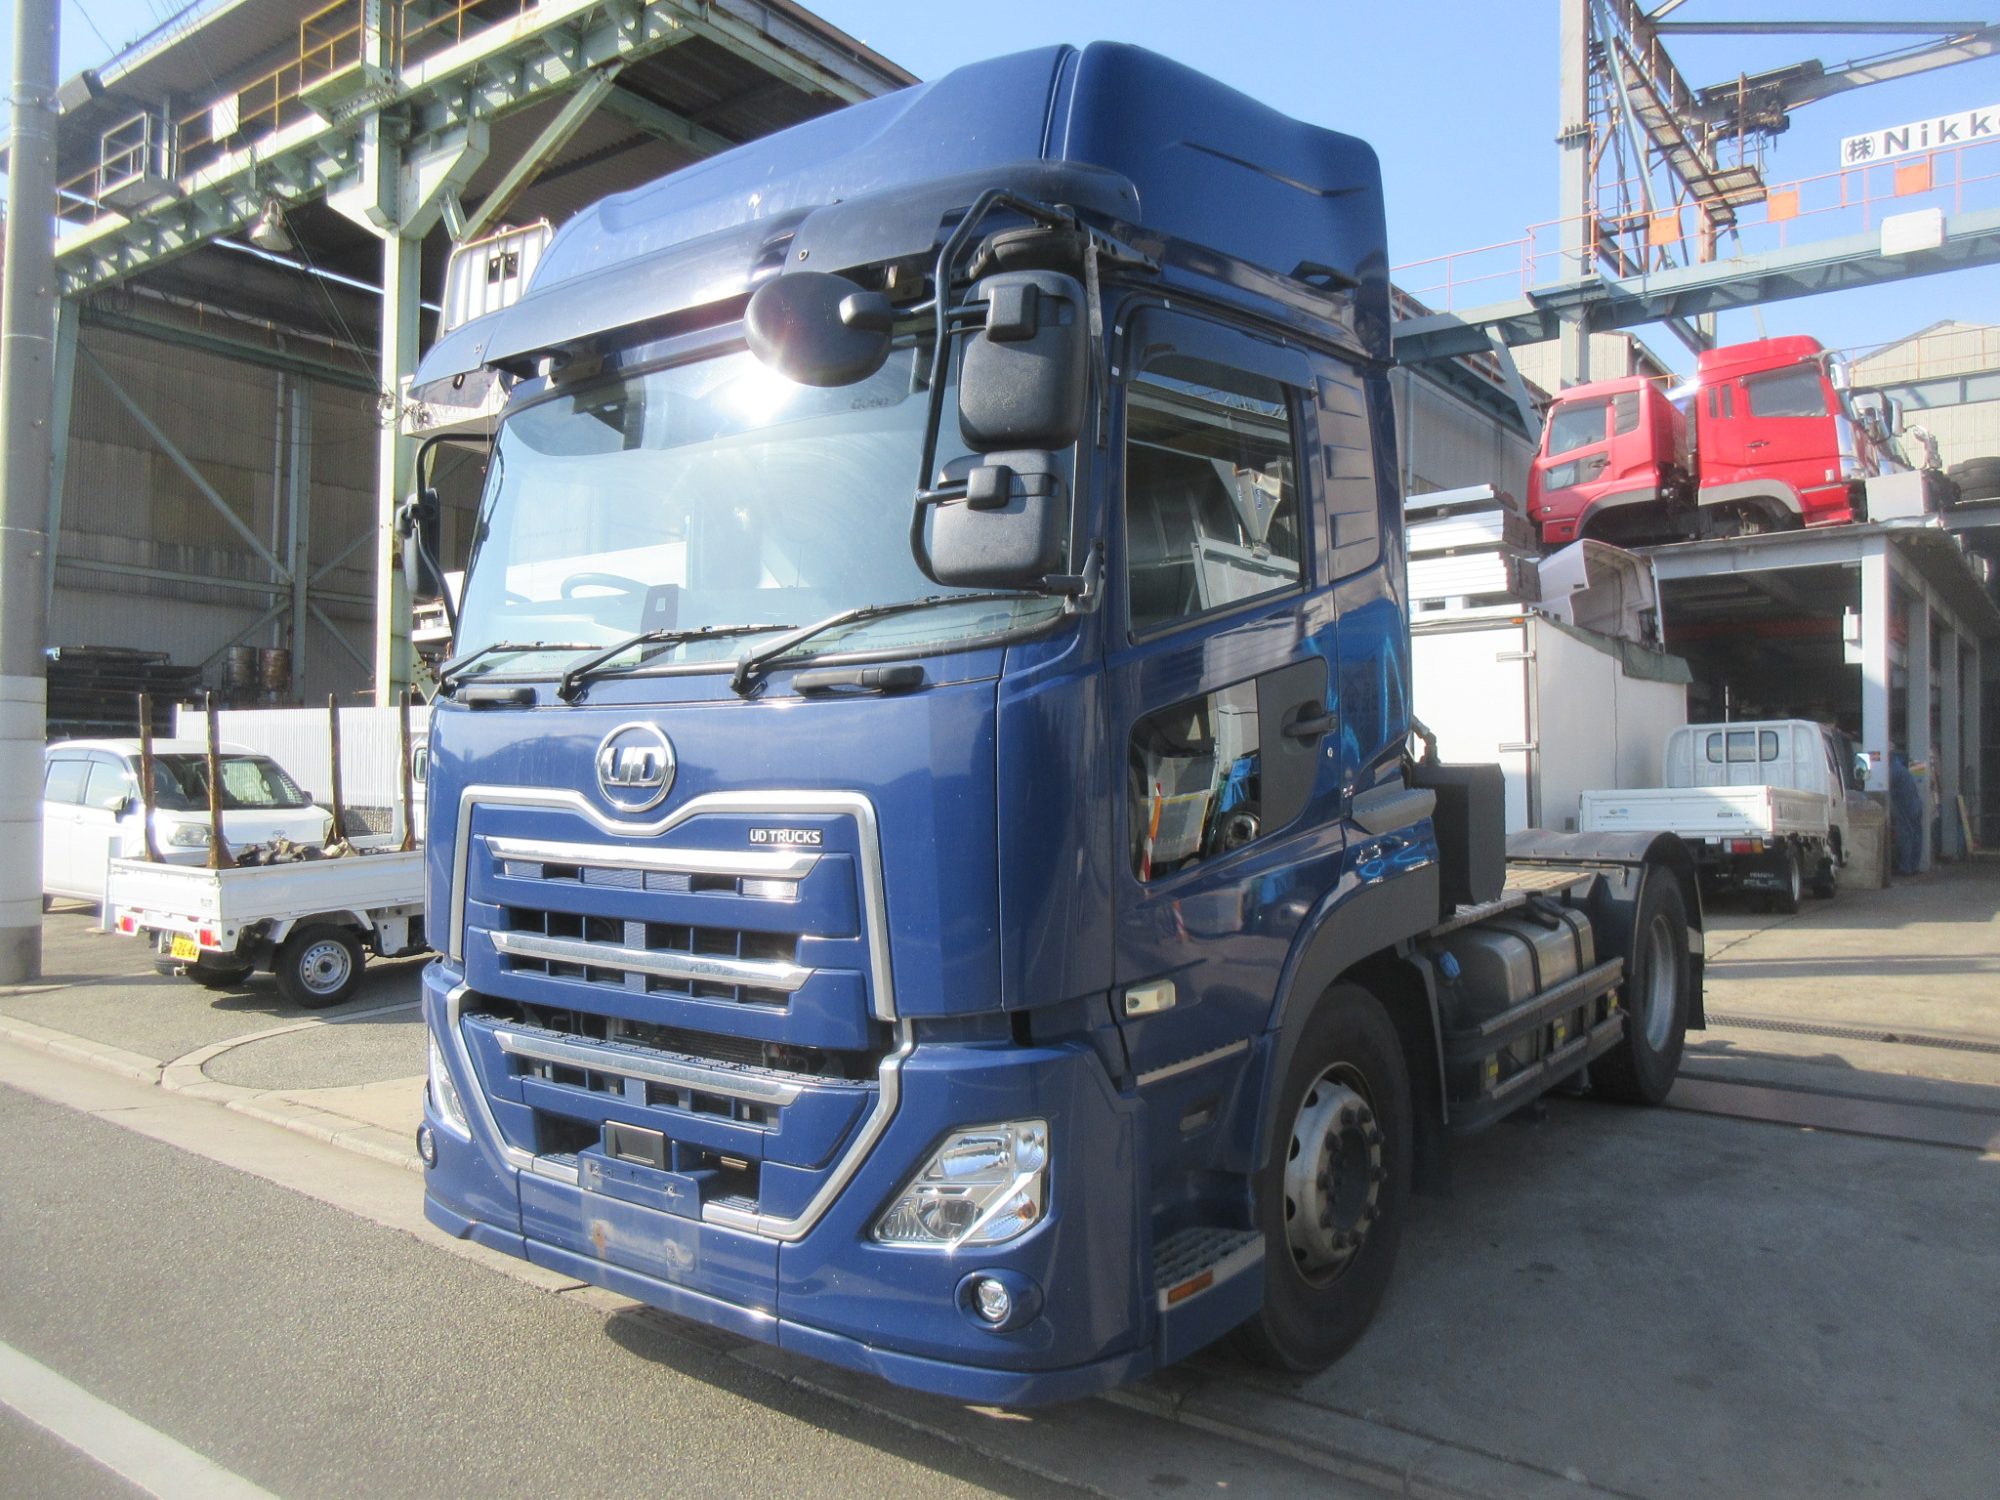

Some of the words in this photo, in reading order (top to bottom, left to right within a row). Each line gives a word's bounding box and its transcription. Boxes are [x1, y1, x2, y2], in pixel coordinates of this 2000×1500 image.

[1884, 112, 2000, 155] Nikk
[601, 746, 667, 786] UD
[750, 829, 767, 842] UD
[769, 830, 821, 844] TRUCKS
